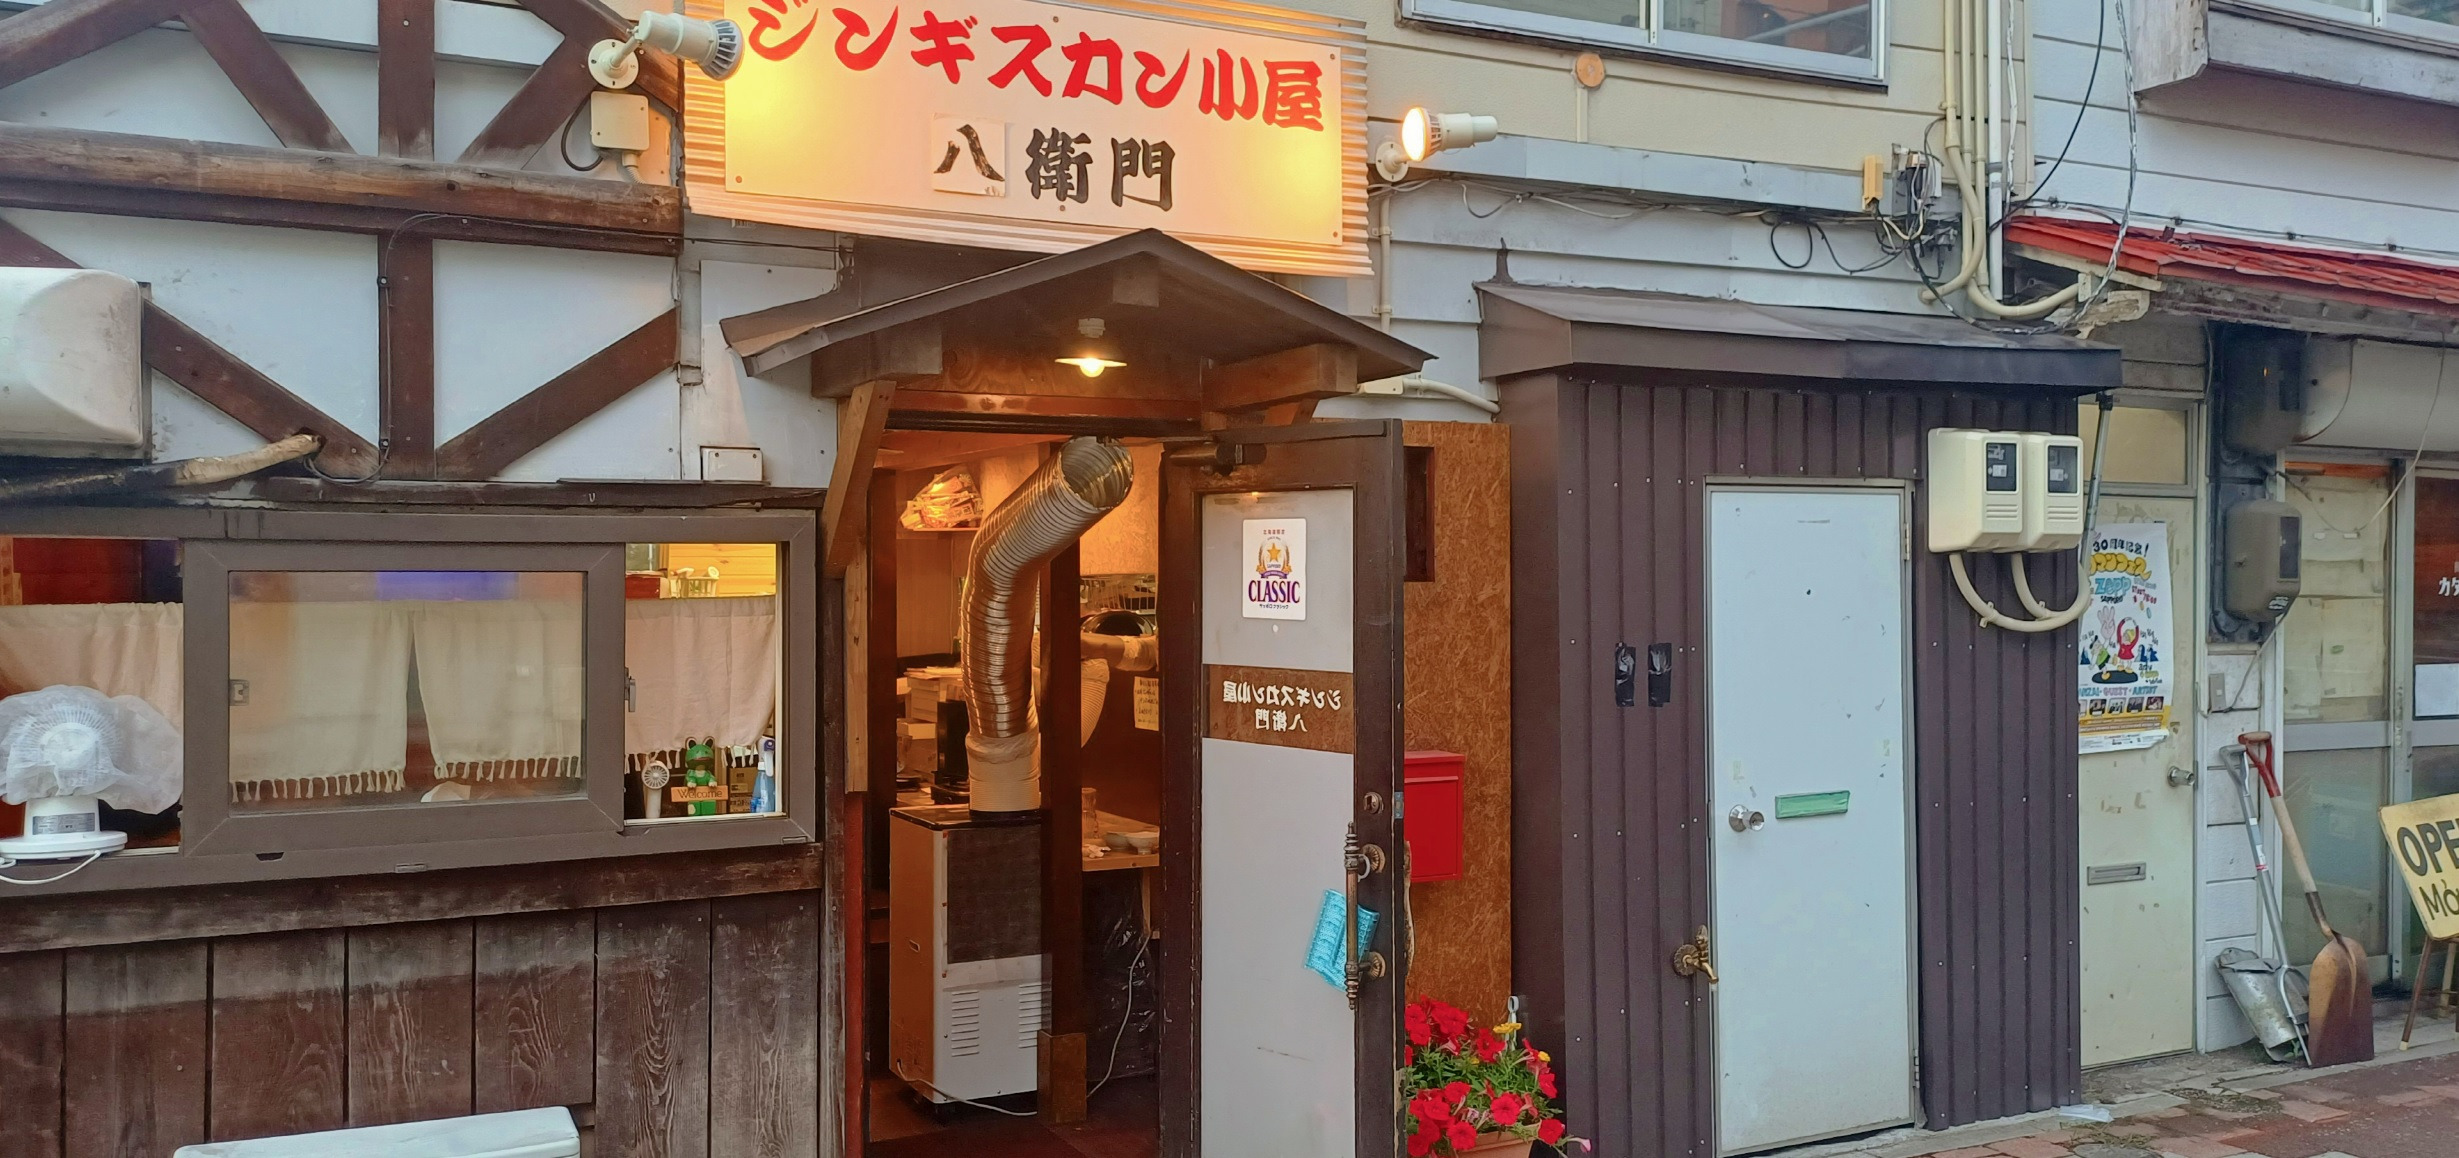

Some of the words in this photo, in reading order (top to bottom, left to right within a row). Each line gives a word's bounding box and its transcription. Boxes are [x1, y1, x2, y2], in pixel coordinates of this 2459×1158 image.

[747, 0, 1323, 131] ジンギスカン小屋
[933, 123, 1176, 212] 八衛門
[1248, 580, 1300, 603] CLASSIC
[677, 788, 723, 800] Welcome
[2397, 818, 2459, 877] OPE
